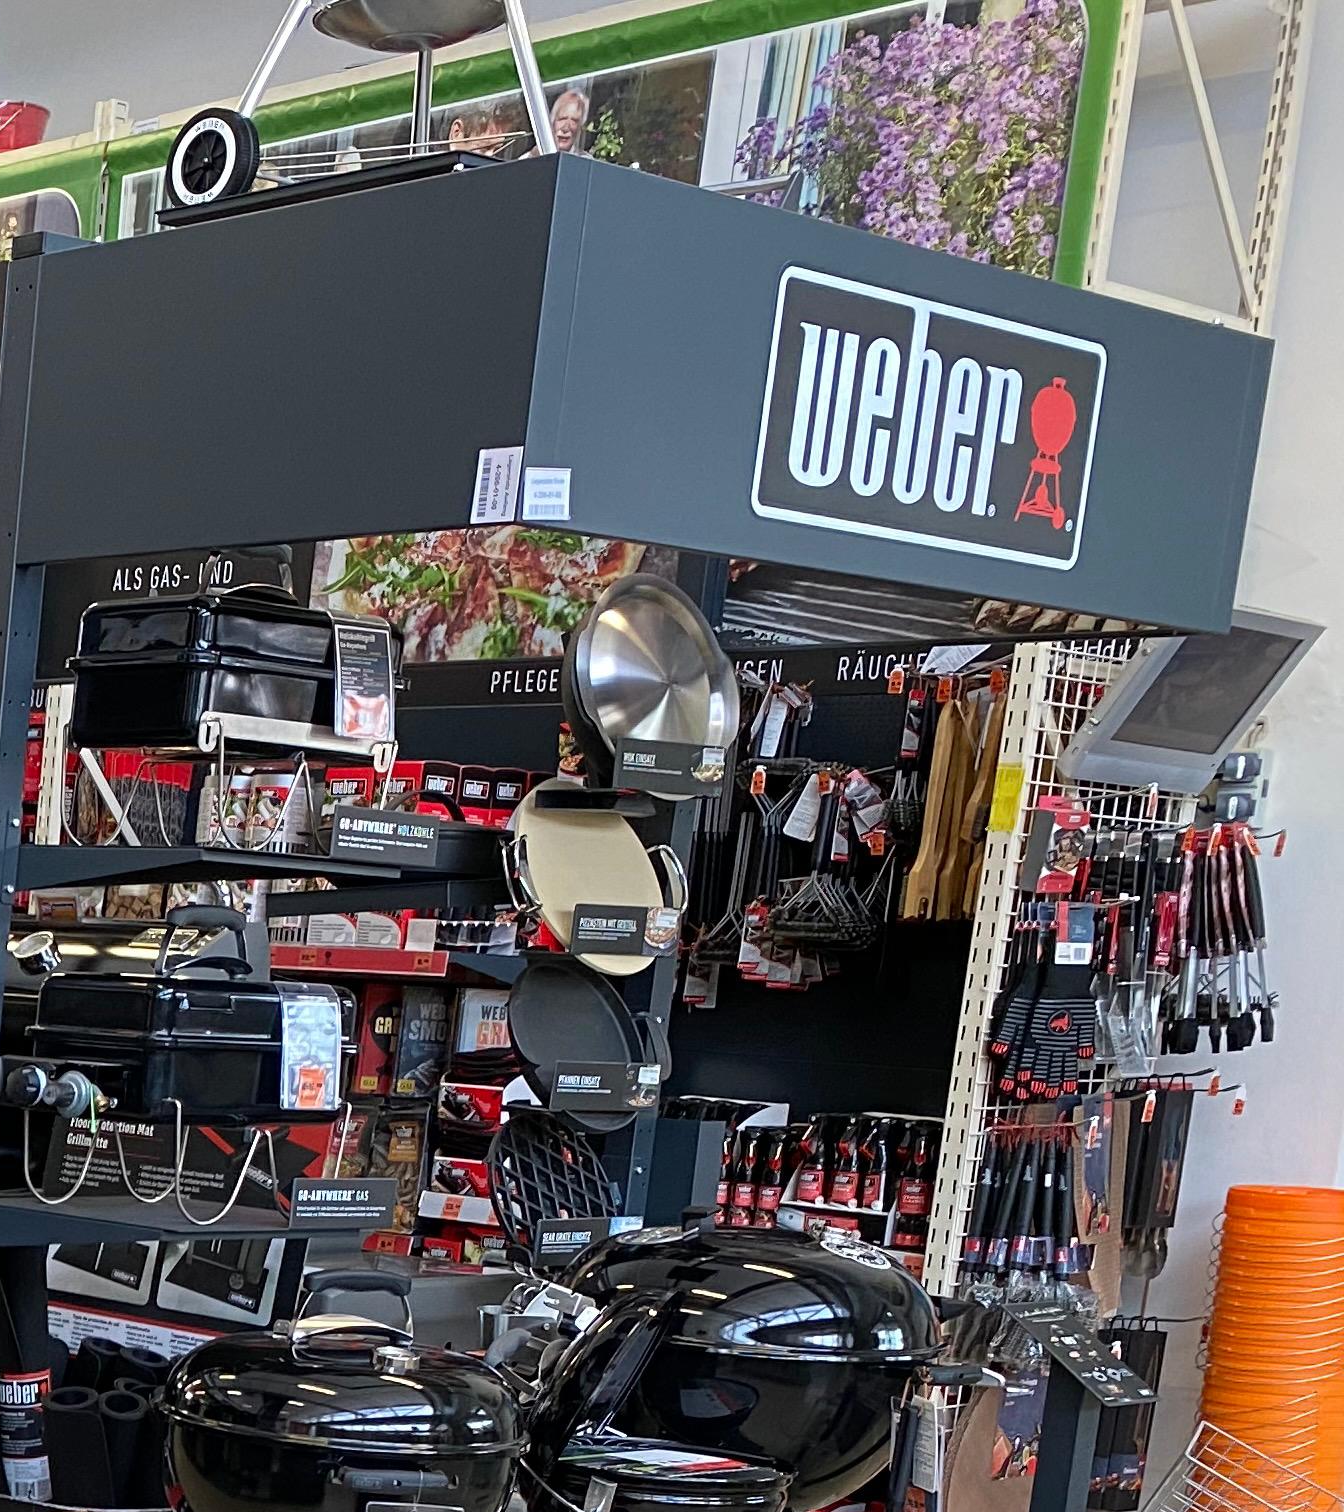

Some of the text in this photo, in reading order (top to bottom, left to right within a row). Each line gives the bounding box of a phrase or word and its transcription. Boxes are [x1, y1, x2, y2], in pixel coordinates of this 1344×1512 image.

[789, 300, 1024, 516] weber
[112, 567, 143, 591] ALS
[150, 564, 190, 589] GAS-
[490, 668, 560, 695] PFLEGE
[136, 1123, 154, 1137] Mat
